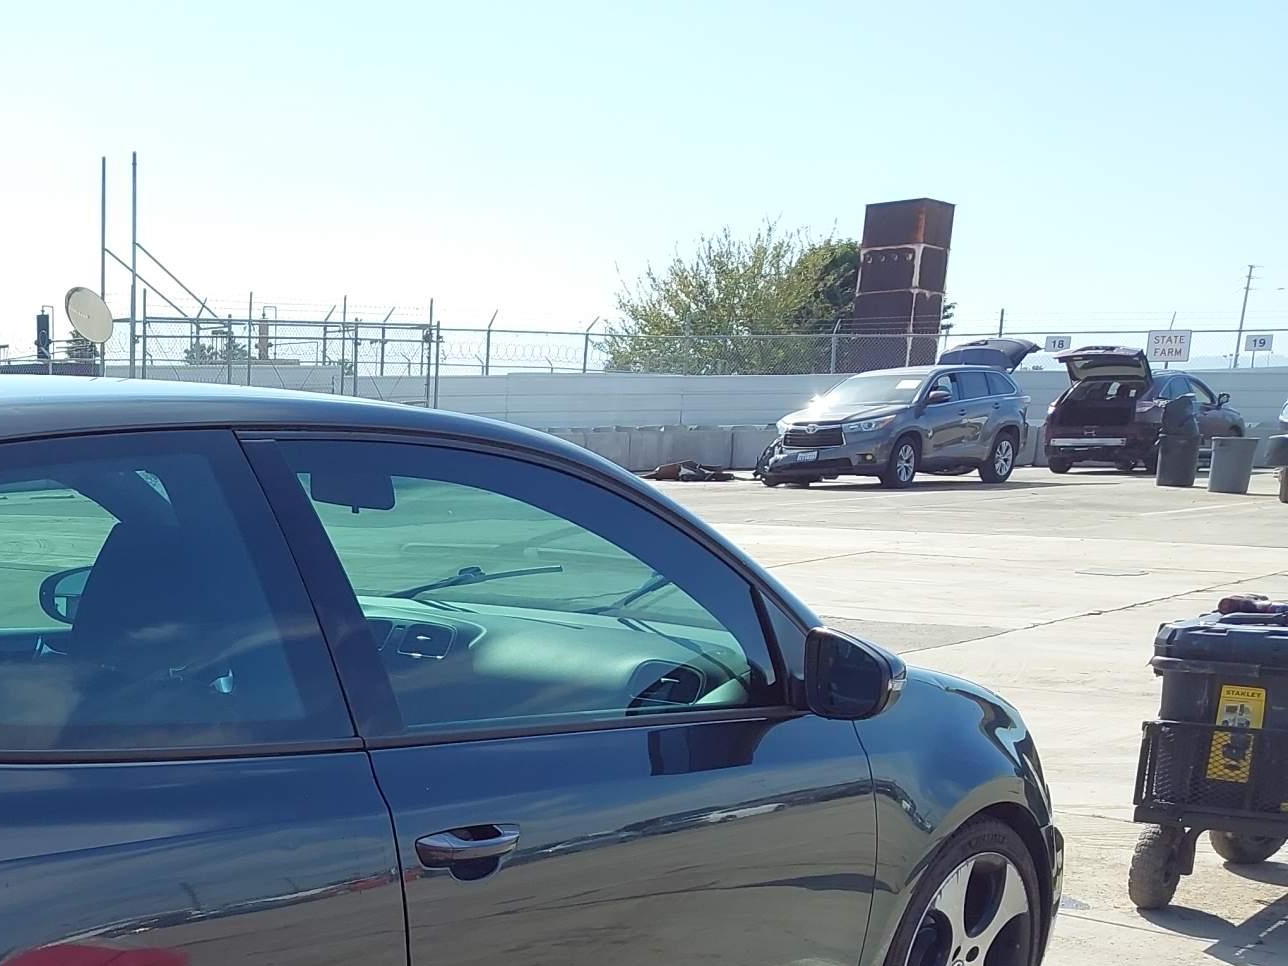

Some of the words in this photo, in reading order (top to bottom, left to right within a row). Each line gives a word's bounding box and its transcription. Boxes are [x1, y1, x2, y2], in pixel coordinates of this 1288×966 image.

[1051, 339, 1064, 349] 18
[1153, 335, 1185, 344] STATE
[1252, 338, 1266, 348] 19
[1153, 347, 1182, 357] FARM
[1225, 690, 1262, 698] STANLEY
